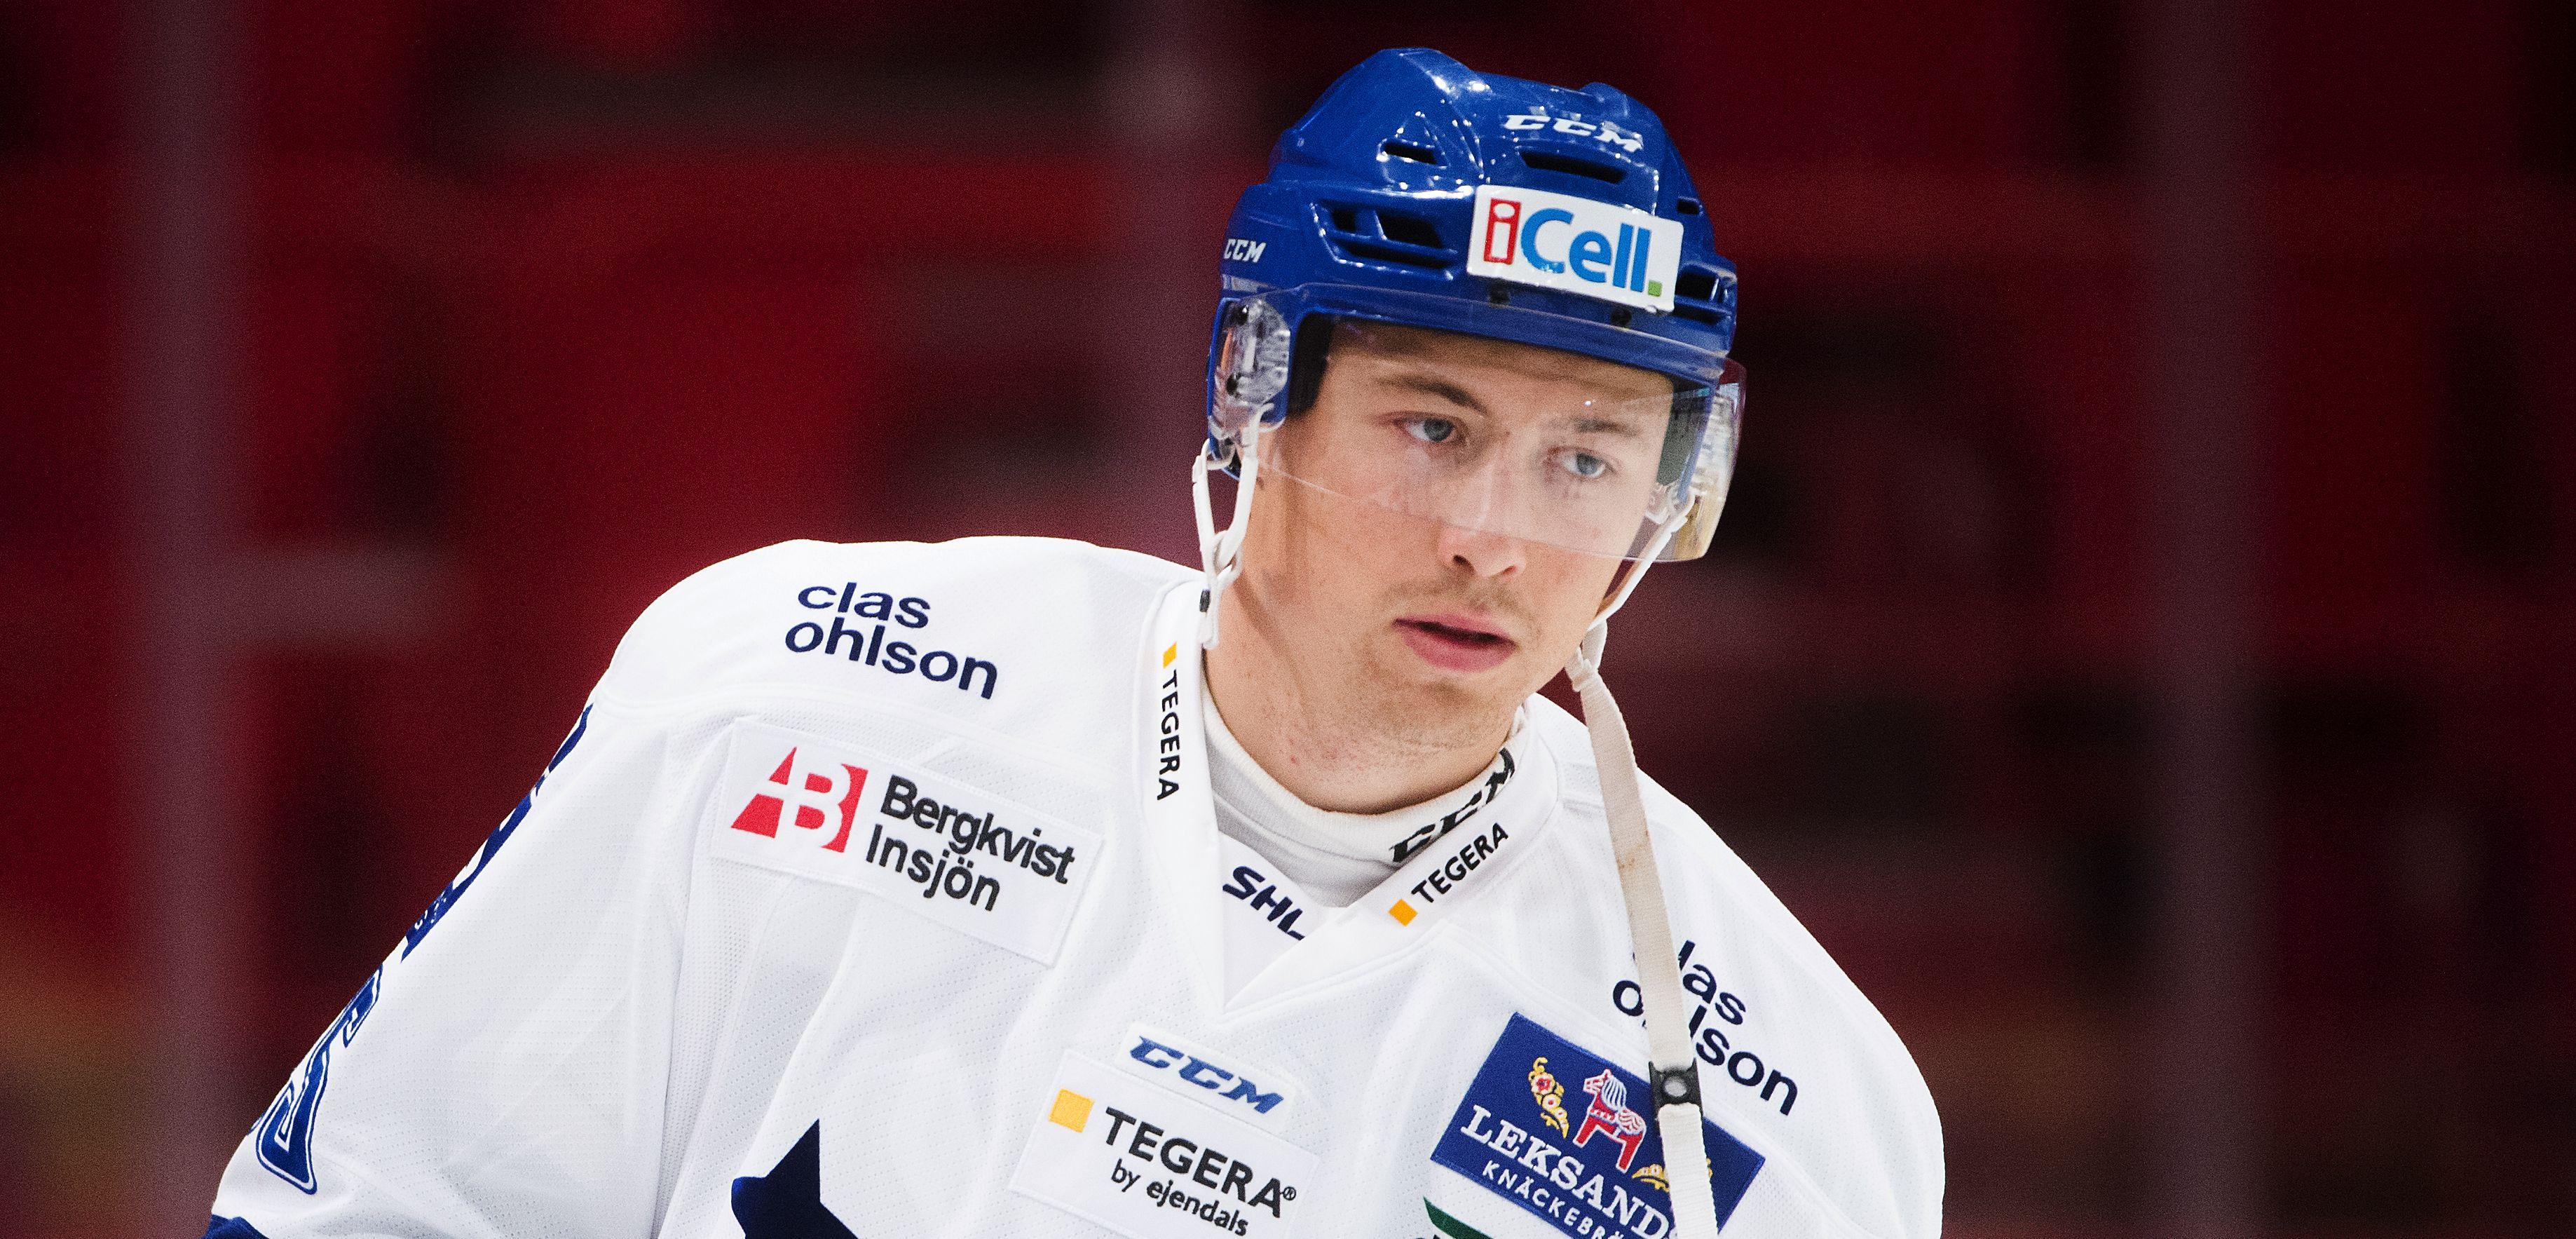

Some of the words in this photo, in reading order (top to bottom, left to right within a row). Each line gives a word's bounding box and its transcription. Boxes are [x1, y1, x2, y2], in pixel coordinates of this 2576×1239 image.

[1504, 114, 1644, 153] CCM
[1223, 238, 1267, 263] CCM
[798, 582, 931, 629] clas
[785, 617, 998, 700] ohlson
[1157, 669, 1180, 801] TEGERA
[866, 823, 1001, 912] Insjön
[880, 774, 1075, 885] Bergkvist
[1411, 822, 1508, 903] TEGERA
[1222, 866, 1306, 941] SHL
[1633, 940, 1746, 1025] las
[1129, 1036, 1284, 1114] CCM
[1612, 980, 1798, 1116] olson
[1111, 1158, 1141, 1193] by
[1146, 1179, 1248, 1237] ejendals
